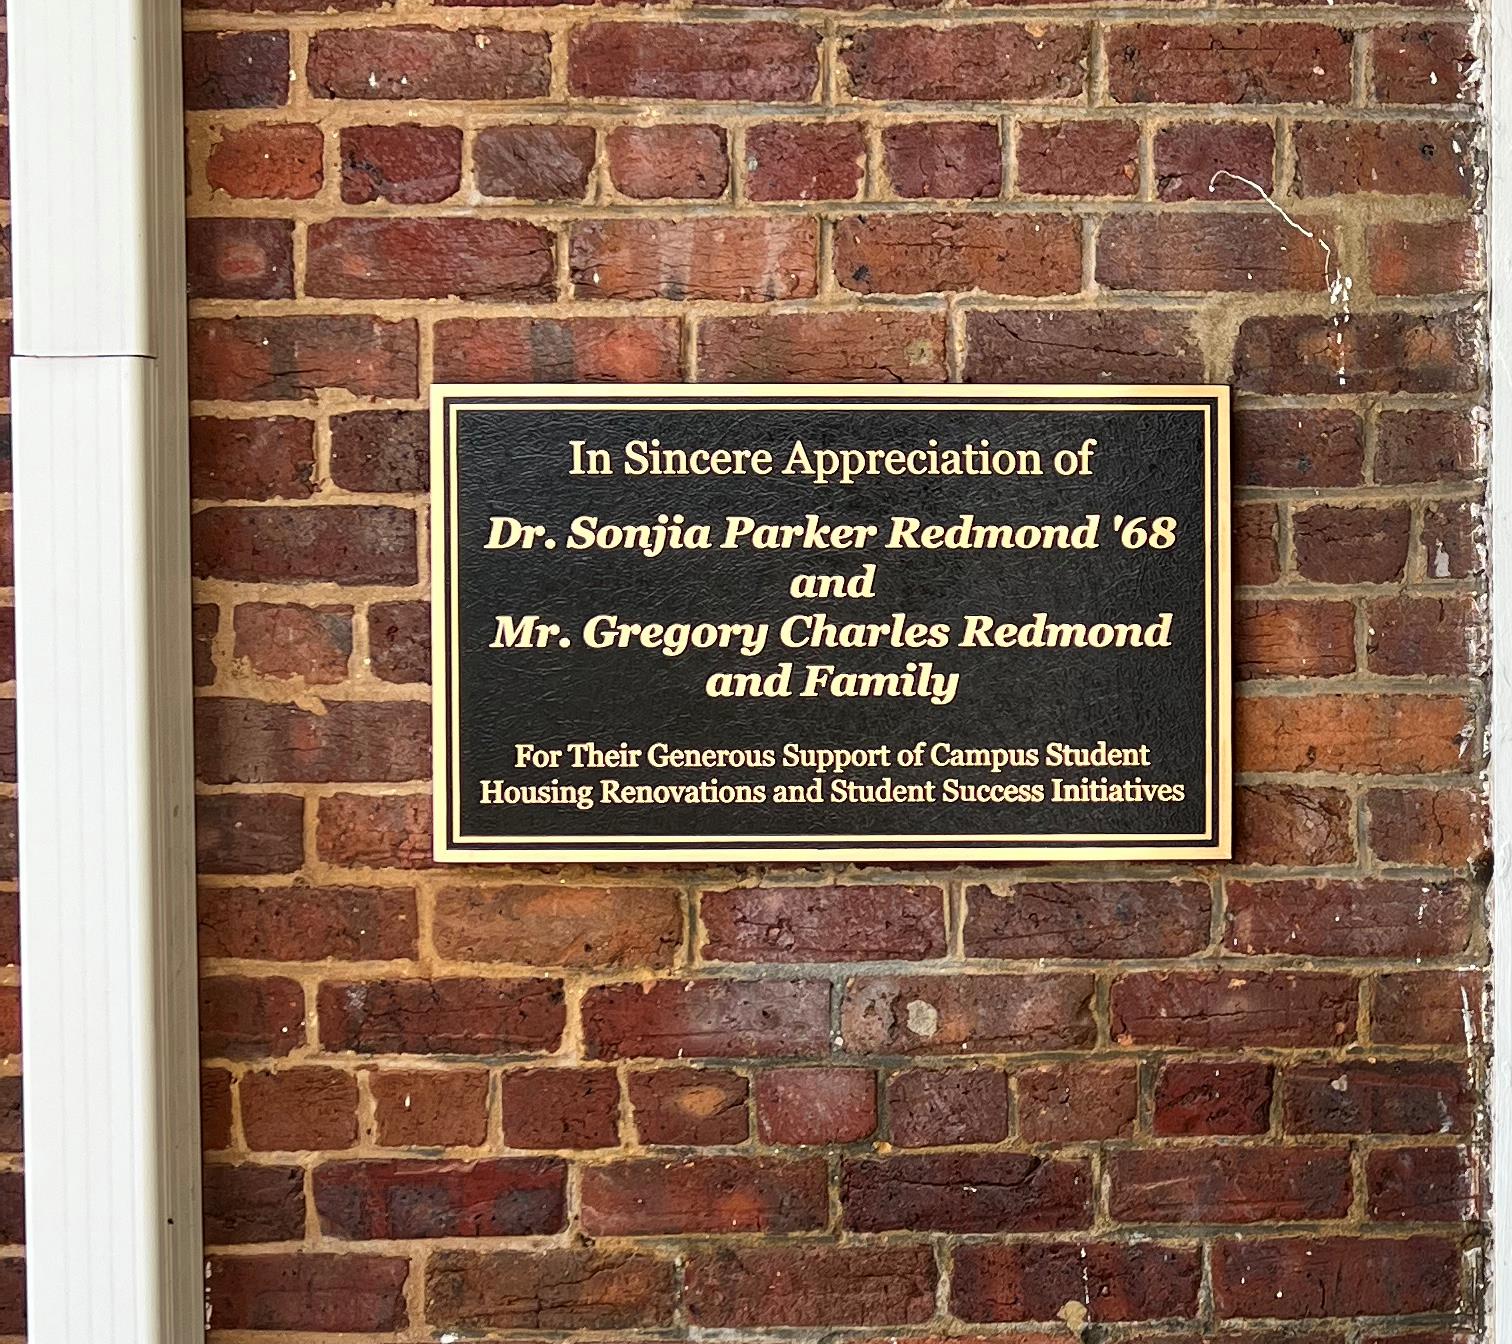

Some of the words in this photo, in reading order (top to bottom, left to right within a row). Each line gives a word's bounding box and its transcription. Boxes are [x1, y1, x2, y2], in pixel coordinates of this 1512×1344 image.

[568, 438, 614, 475] In
[624, 437, 773, 475] Sincere
[781, 438, 1044, 485] Appreciation
[1053, 437, 1098, 476] of
[483, 516, 557, 550] Dr.
[565, 513, 713, 558] Sonjia
[719, 513, 878, 552] Parker
[884, 514, 1101, 549] Redmond
[1113, 514, 1177, 550] '68
[789, 563, 877, 599] and
[488, 615, 571, 649] Mr.
[582, 614, 770, 657] Gregory
[779, 612, 951, 648] Charles
[957, 612, 1174, 648] Redmond
[705, 662, 793, 698] and
[799, 662, 960, 705] Family
[514, 743, 563, 768] For
[566, 741, 643, 768] Their
[647, 742, 776, 768] Generous
[782, 743, 892, 774] Support
[896, 741, 927, 767] of
[930, 742, 1040, 773] Campus
[1045, 740, 1152, 767] Student
[479, 778, 594, 810] Housing
[599, 777, 767, 804] Renovations
[772, 777, 825, 803] and
[830, 777, 937, 803] Student
[942, 778, 1045, 803] Success
[1050, 776, 1186, 803] Initiatives
